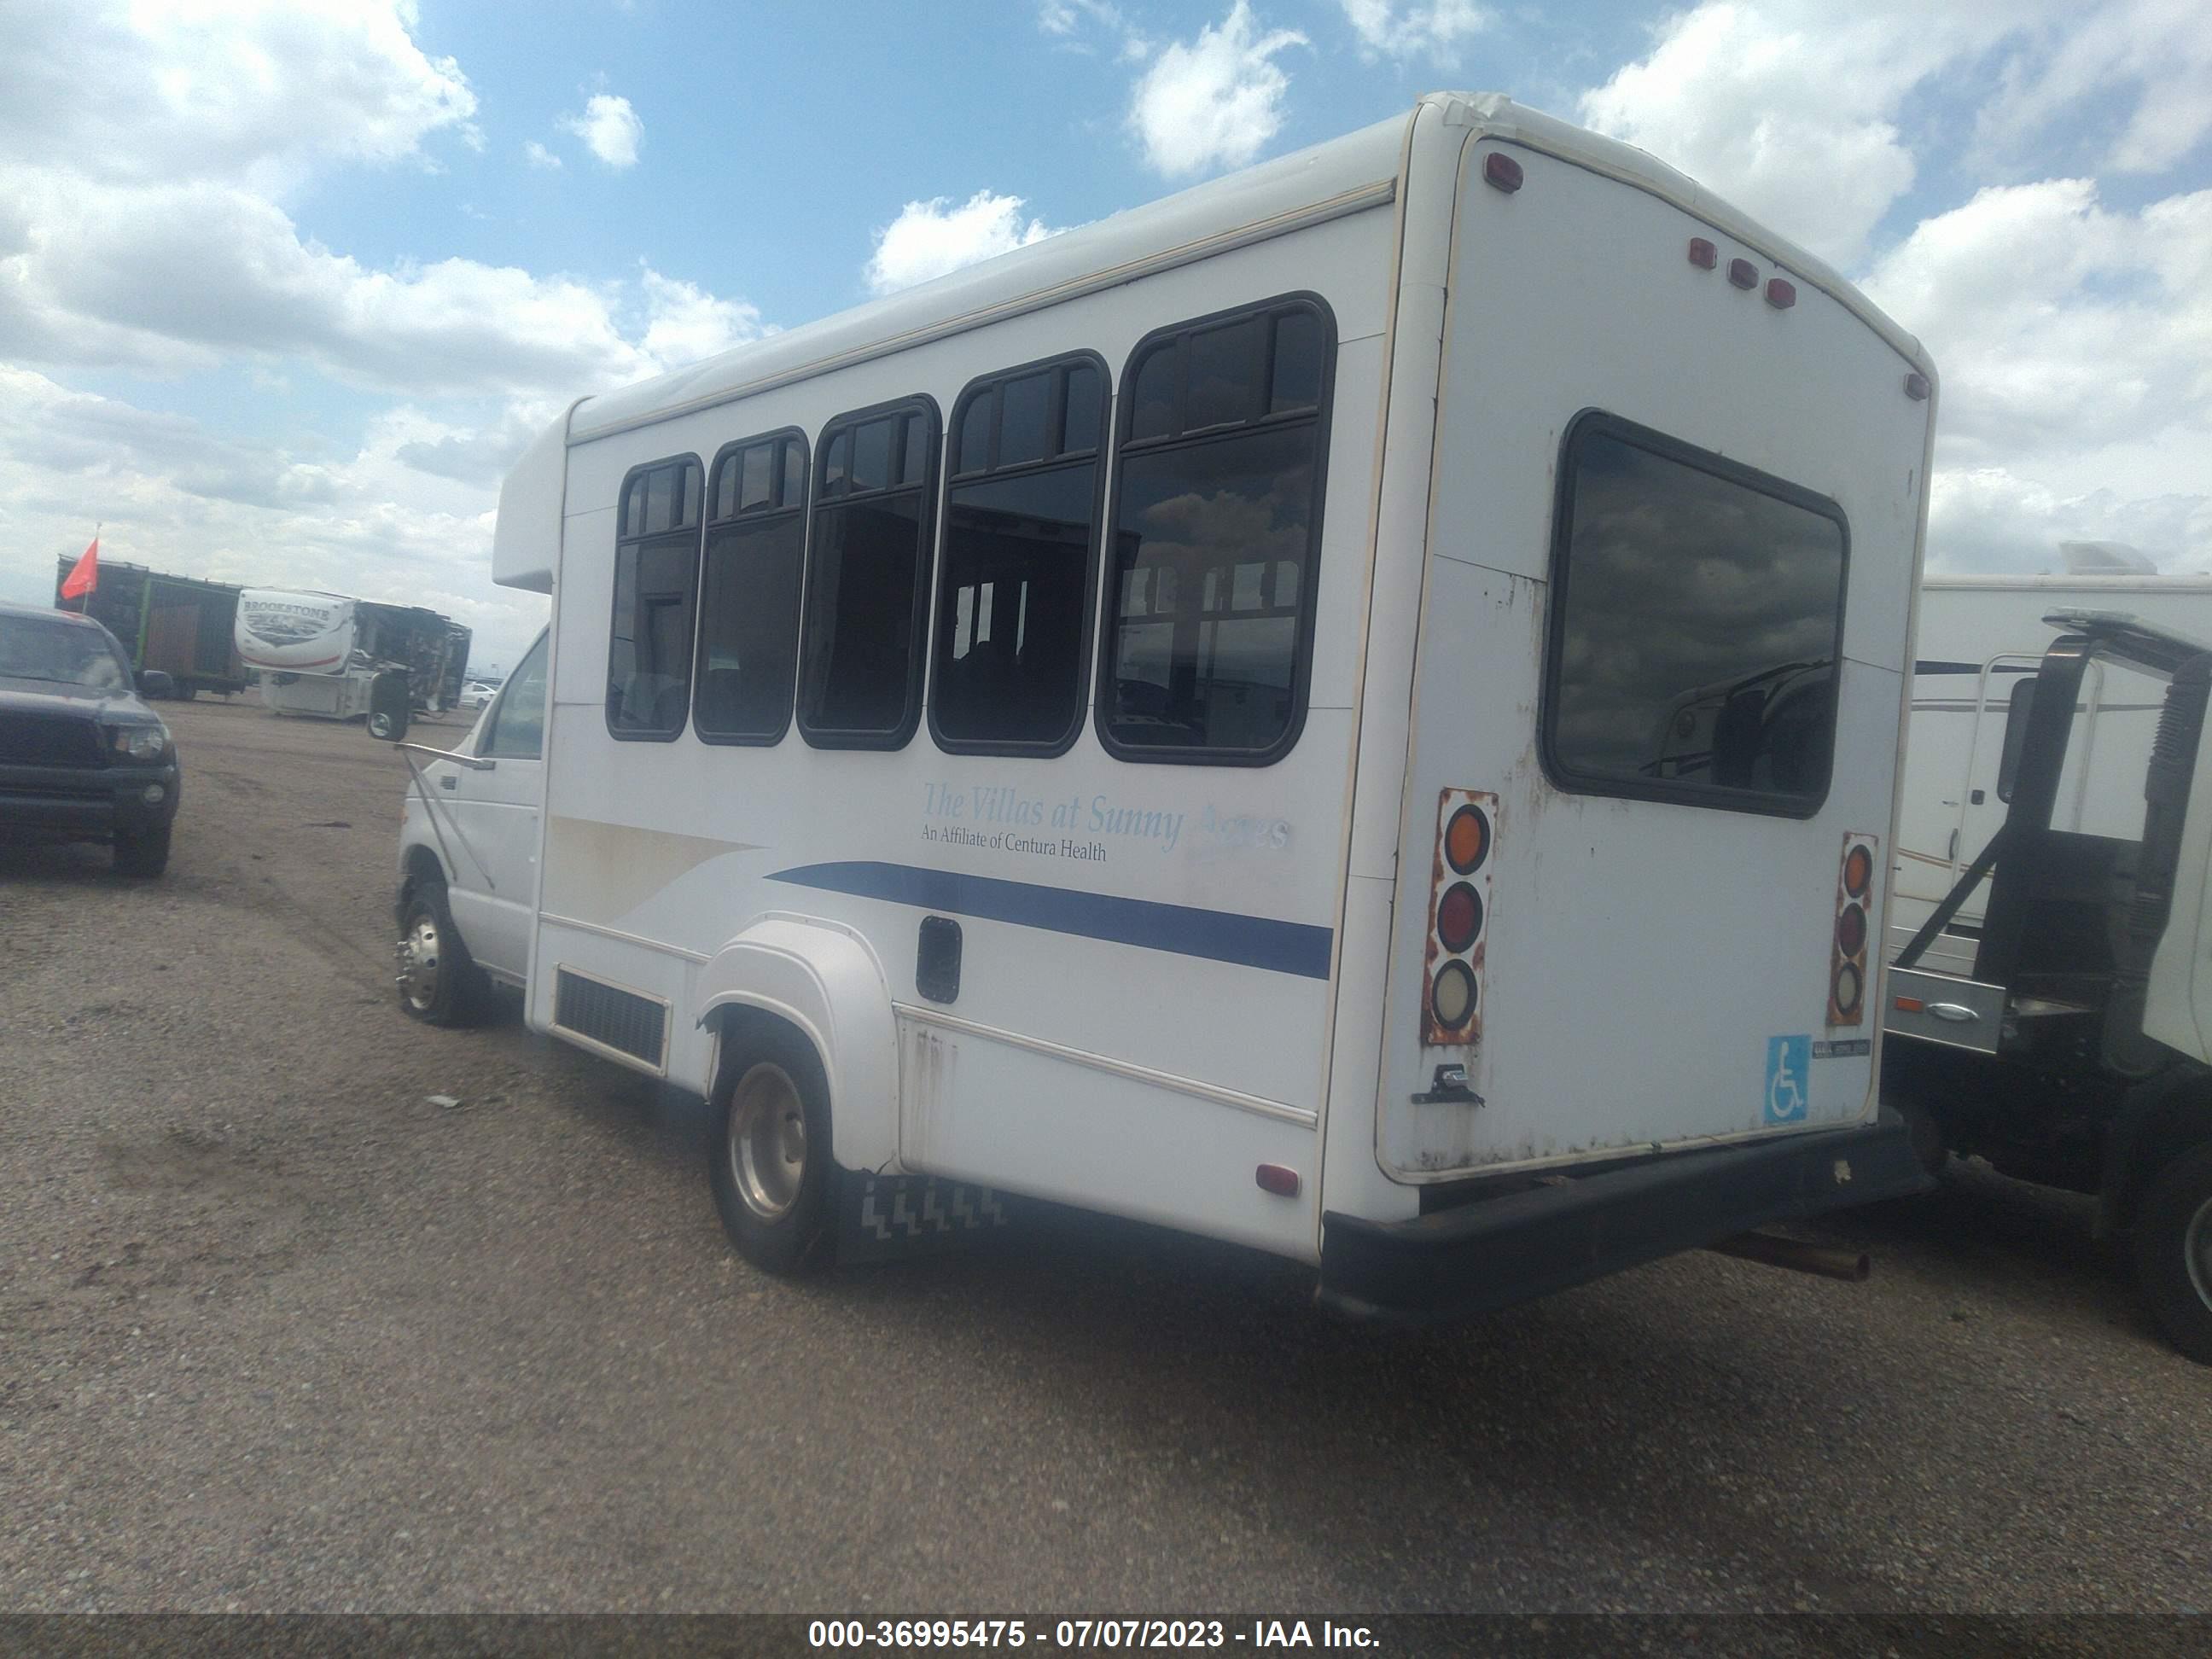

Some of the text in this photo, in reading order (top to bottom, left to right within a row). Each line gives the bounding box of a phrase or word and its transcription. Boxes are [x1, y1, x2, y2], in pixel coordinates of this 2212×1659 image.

[244, 601, 329, 620] BROOKSTONE
[924, 783, 964, 817] The
[971, 786, 1045, 826] Villas
[1051, 796, 1080, 829] at
[1090, 795, 1185, 853] Sunny
[921, 824, 1108, 862] An Affiliate of Centura Health
